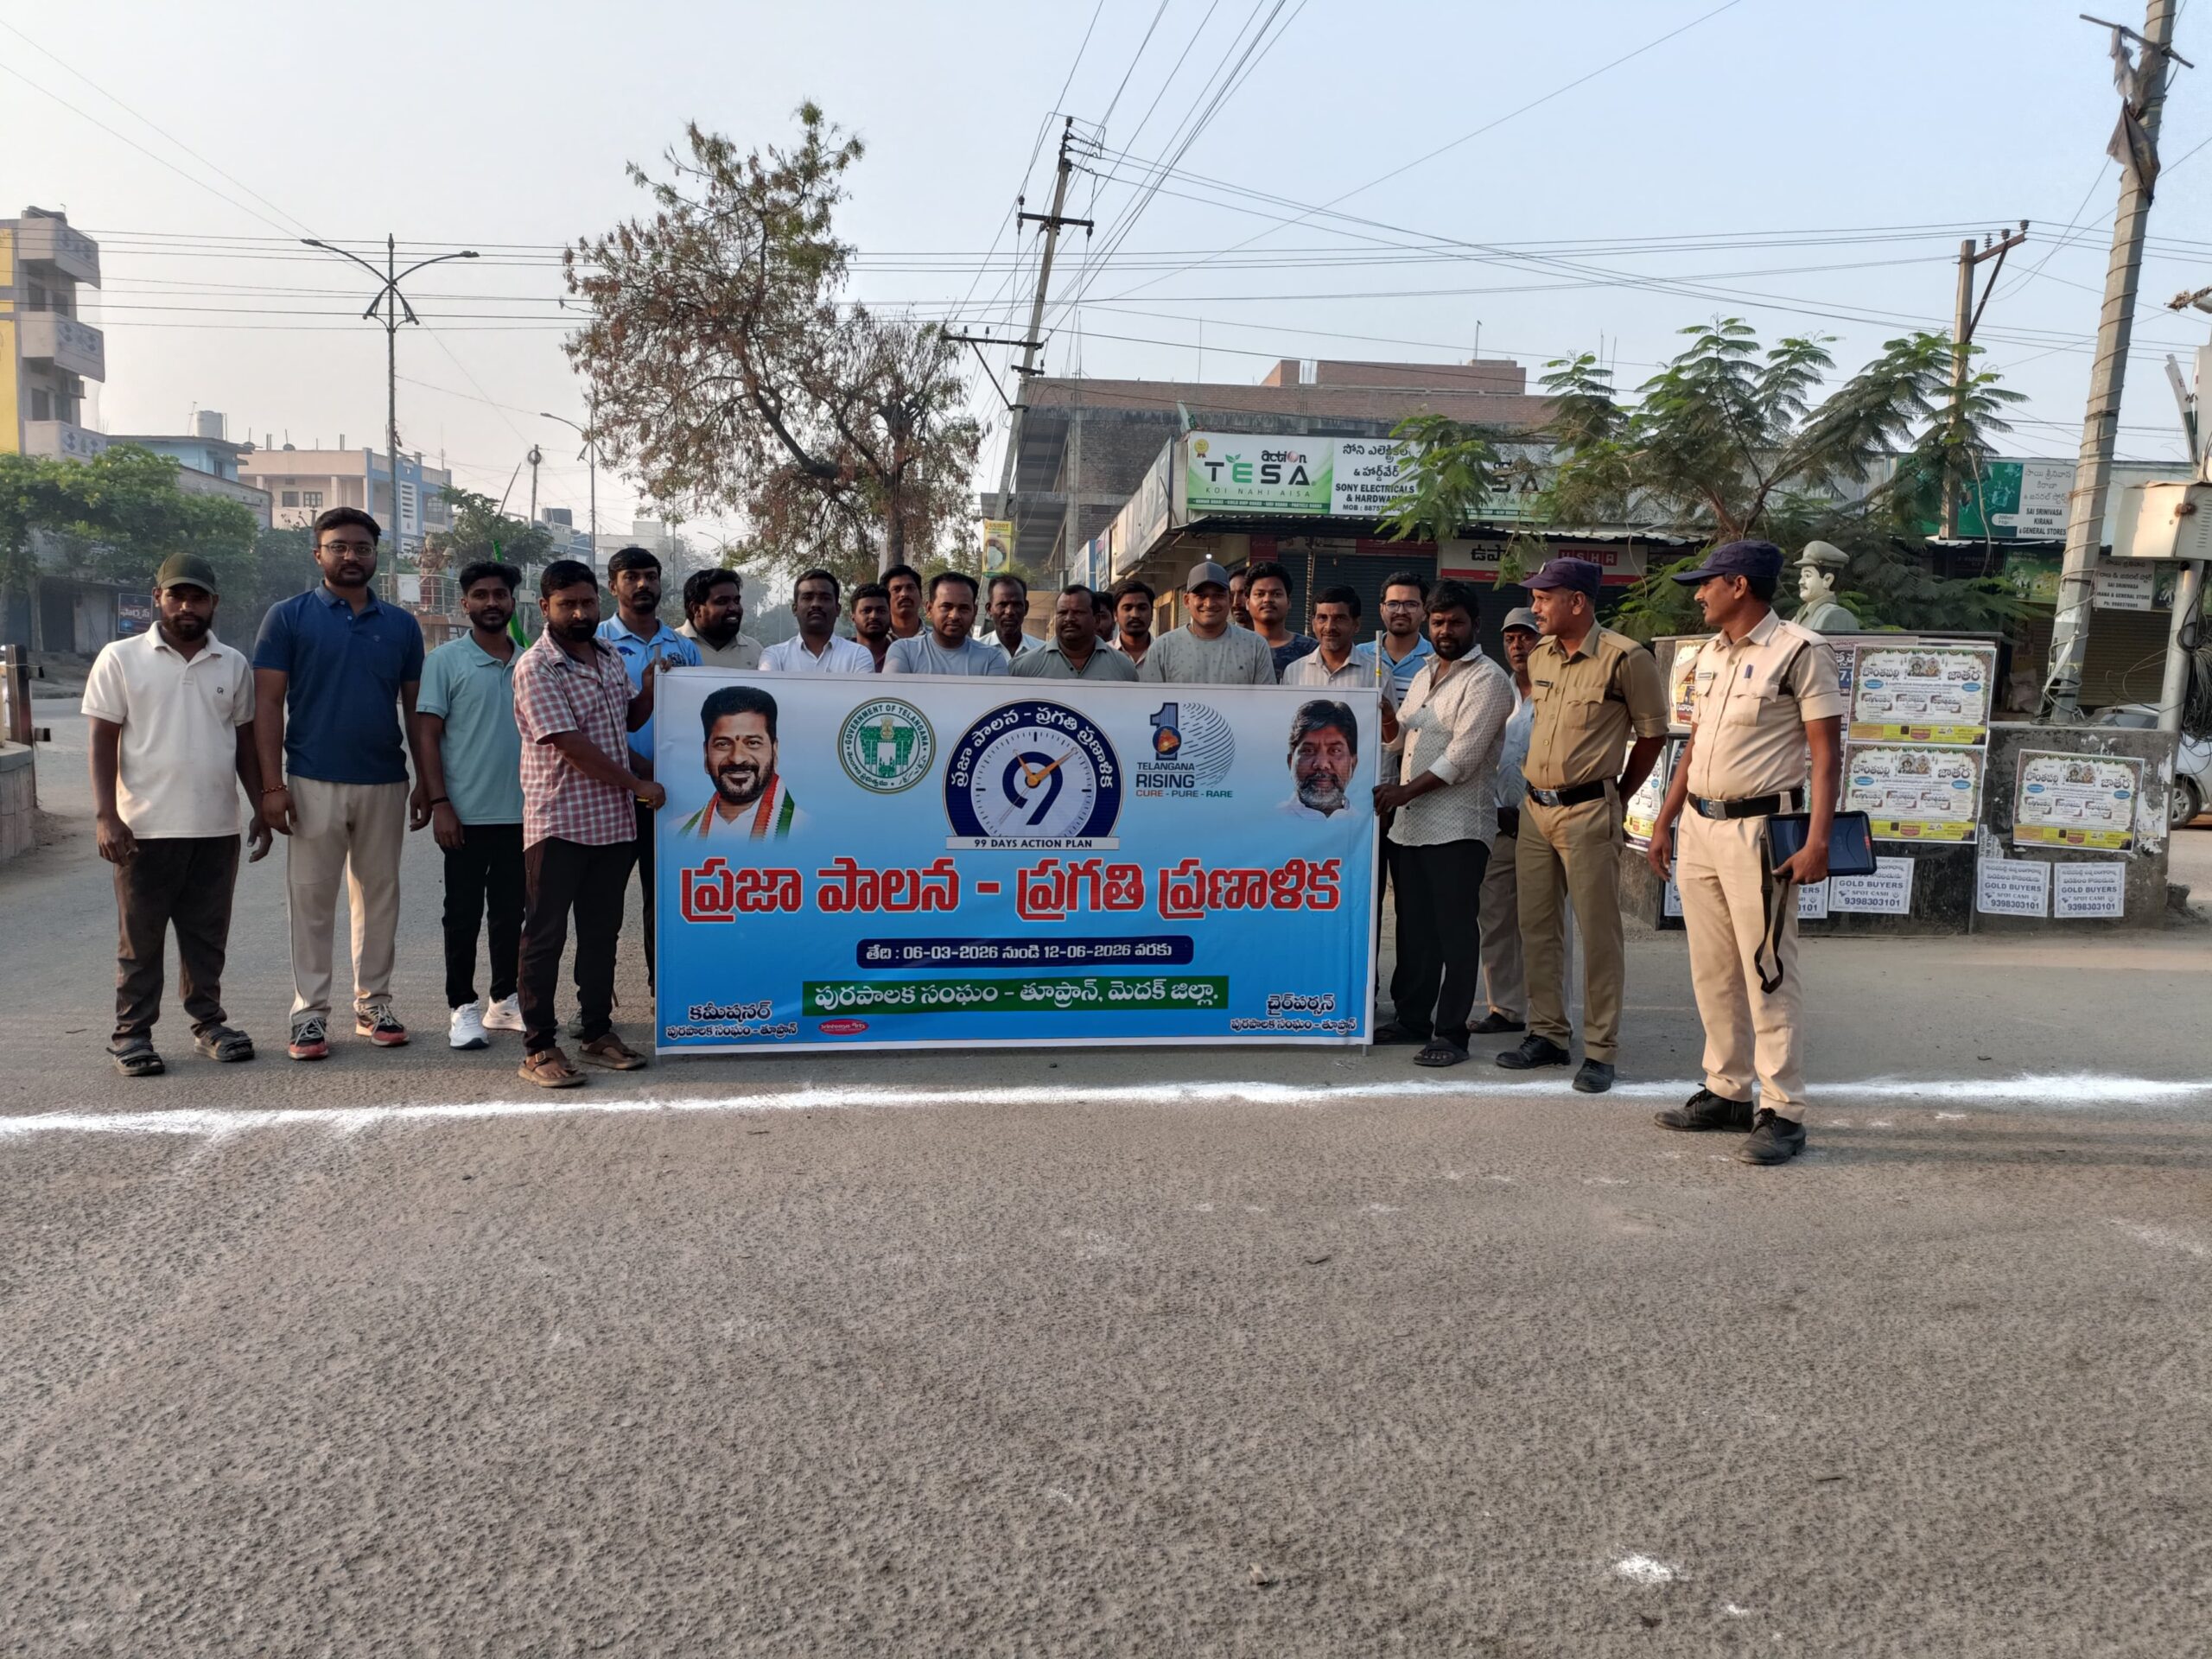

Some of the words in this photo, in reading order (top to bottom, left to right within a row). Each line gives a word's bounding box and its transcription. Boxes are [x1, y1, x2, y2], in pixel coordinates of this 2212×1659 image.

[1205, 461, 1310, 486] TESA
[1335, 483, 1359, 493] SONY
[1360, 484, 1415, 493] ELECTRICALS
[2036, 508, 2063, 517] SRINIVASA
[844, 705, 883, 745] GOVERNMENT
[899, 707, 930, 747] TELANGANA
[951, 747, 973, 787] ప్రజా
[971, 709, 1020, 747] పాలన
[1035, 707, 1078, 731] ప్రగతి
[1076, 726, 1114, 788] ప్రణాళిక
[1137, 762, 1195, 771] TELANGANA
[1136, 773, 1195, 788] RISING
[1135, 789, 1164, 798] CURE
[974, 839, 987, 848] 99
[991, 839, 1018, 849] DAYS
[1020, 839, 1062, 849] ACTION
[1065, 839, 1092, 849] PLAN
[680, 856, 803, 924] ప్రజా
[816, 856, 961, 913] పాలన
[1015, 857, 1146, 922] ప్రగతి
[1157, 857, 1342, 920] ప్రణాళిక
[1866, 880, 1904, 889] BUYERS
[1984, 881, 2007, 890] GOLD
[2009, 883, 2042, 893] BUYERS
[1844, 897, 1901, 907] 9398303101
[1990, 899, 2040, 910] 9398303101
[2067, 903, 2115, 912] 9398303101
[903, 945, 999, 959] 06-03-2026
[1002, 944, 1040, 959] నుండి
[1044, 944, 1131, 958] 12-06-2026
[1135, 943, 1173, 957] వరకు
[815, 985, 916, 1011] పురపాలక
[920, 983, 999, 1006] సంఘం
[1020, 978, 1103, 1008] తూప్రాన్,
[1108, 979, 1166, 1001] మెదక్
[1171, 982, 1219, 1006] జిల్లా.
[689, 1001, 772, 1023] కమీషనర్
[666, 1024, 714, 1039] పురపాలక
[715, 1023, 751, 1038] సంఘం
[760, 1022, 798, 1039] తూప్రాన్
[1230, 1018, 1276, 1032] పురపాలక
[1277, 1018, 1313, 1032] సంఘం
[1321, 1018, 1357, 1034] తూప్రాన్
